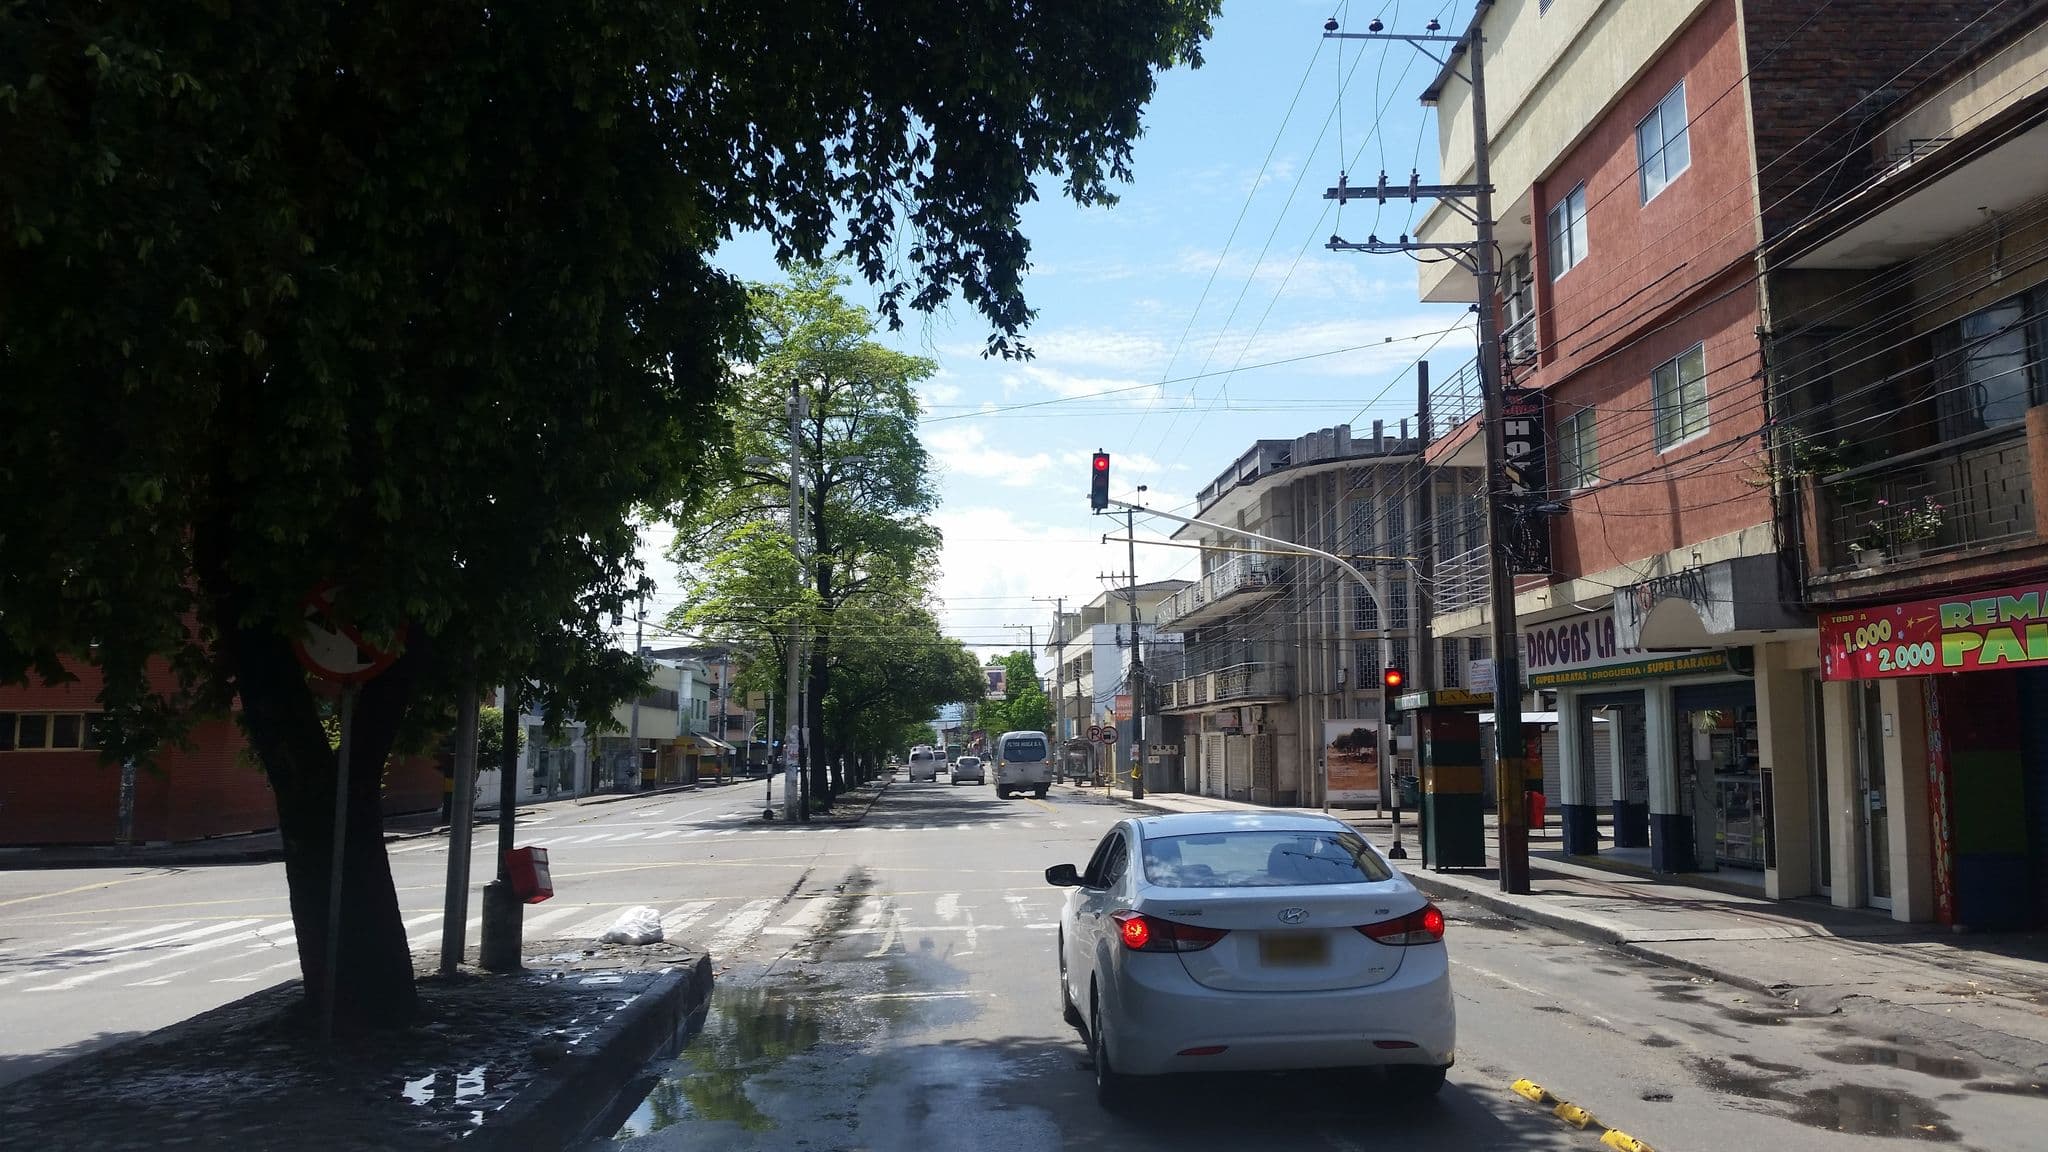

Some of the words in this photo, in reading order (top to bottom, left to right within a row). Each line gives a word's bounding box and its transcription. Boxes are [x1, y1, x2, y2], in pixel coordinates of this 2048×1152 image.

[1831, 614, 1854, 624] TODO
[1860, 613, 1867, 621] A
[1526, 621, 1591, 668] DROGAS
[1594, 615, 1616, 659] LA
[1843, 618, 1892, 654] 1.000
[1535, 673, 1555, 685] SUPER
[1556, 671, 1587, 682] BARATAS
[1592, 666, 1642, 680] DROGUERIA
[1647, 660, 1675, 673] SUPER
[1676, 655, 1722, 670] BARATAS
[1878, 641, 1935, 672] 2.000
